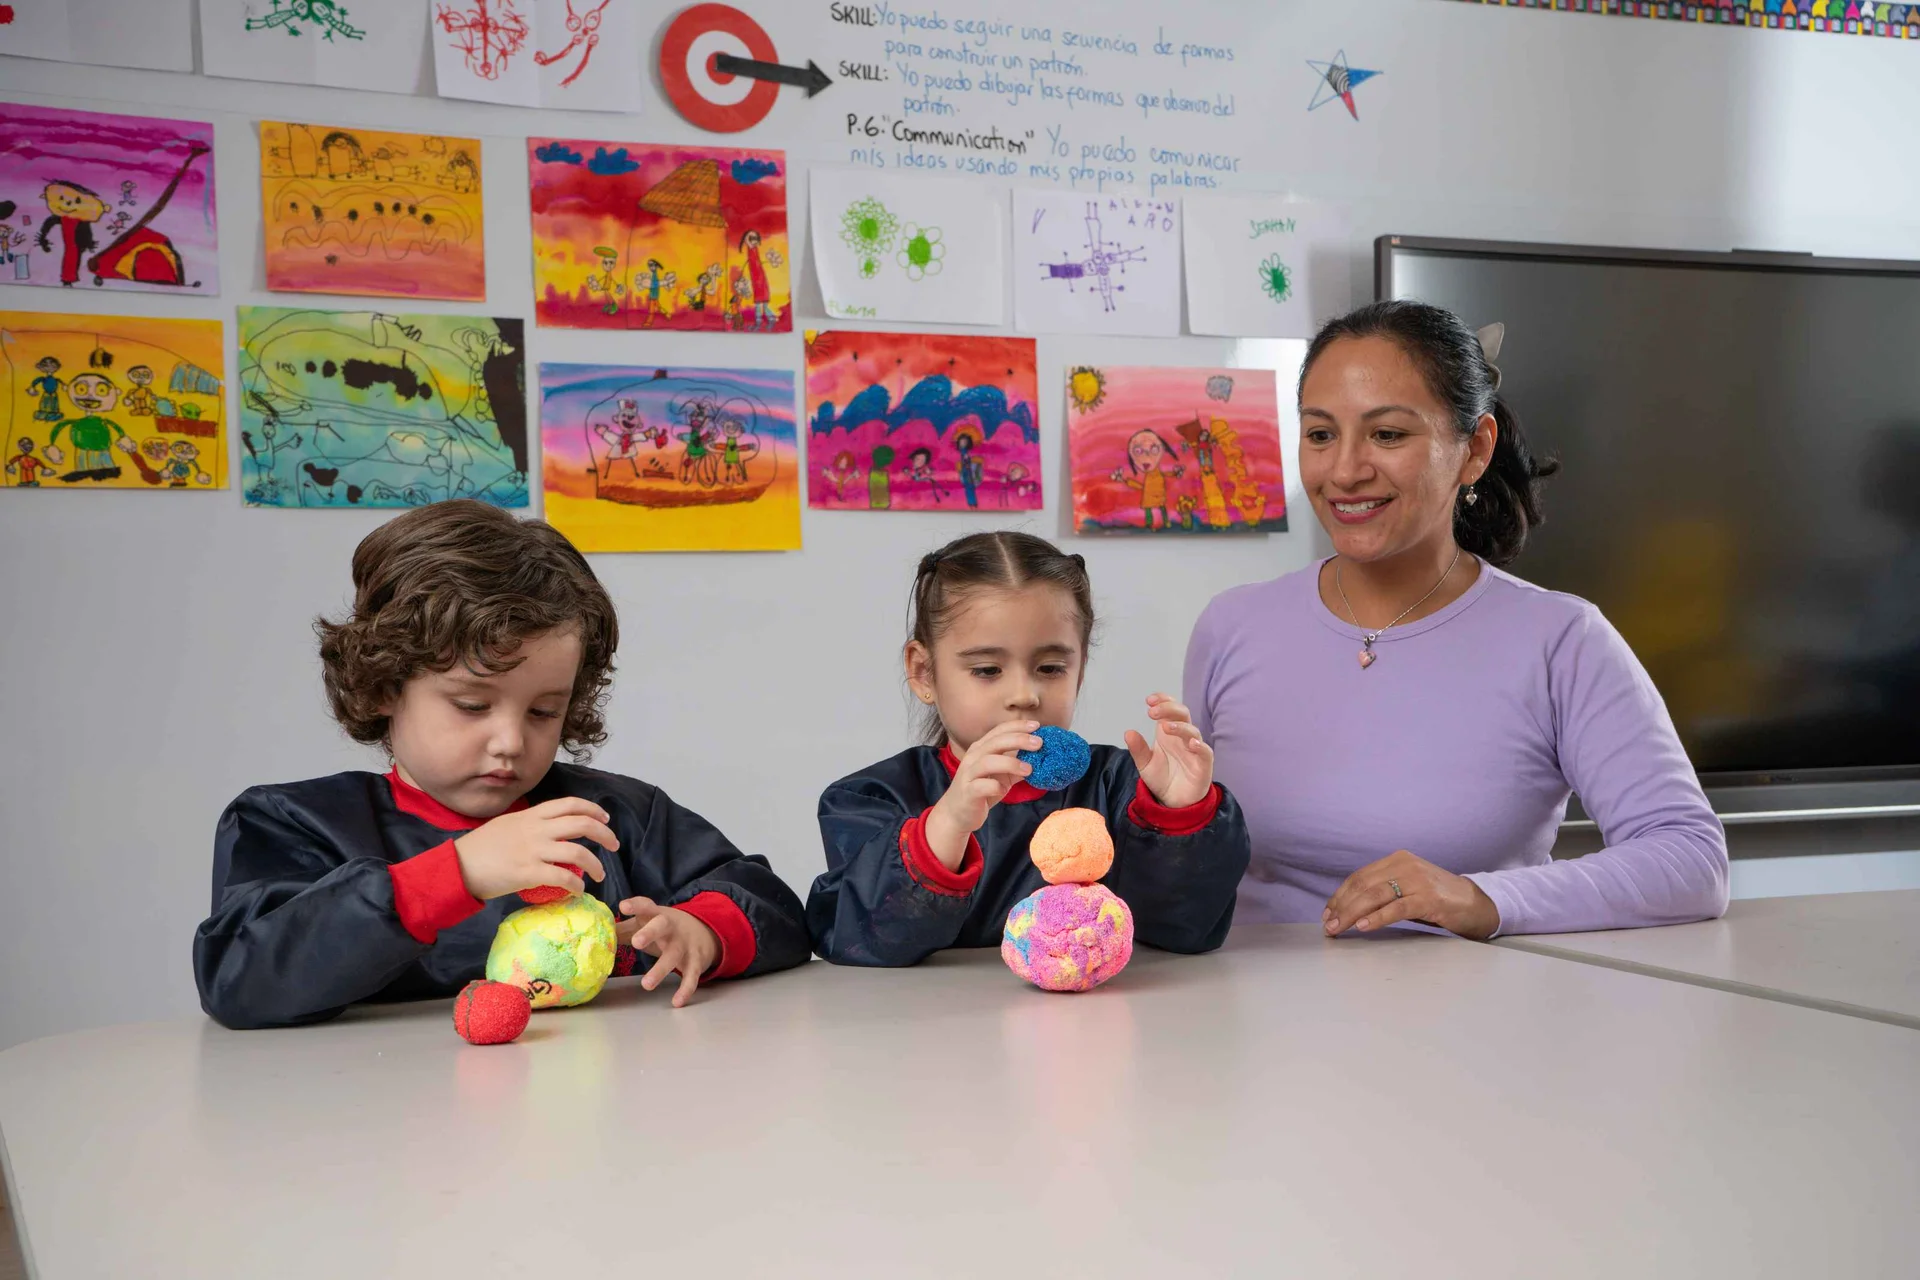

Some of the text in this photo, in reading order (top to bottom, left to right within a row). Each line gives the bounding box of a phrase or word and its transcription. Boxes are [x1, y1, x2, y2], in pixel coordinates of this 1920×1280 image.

[830, 1, 877, 27] SKILL:
[875, 1, 896, 26] Yo
[899, 11, 948, 35] puedo
[953, 17, 1014, 47] seguir
[1021, 26, 1052, 44] una
[1153, 26, 1173, 55] de
[1181, 44, 1235, 67] formas
[884, 39, 923, 61] para
[928, 42, 999, 67] construir
[1002, 55, 1023, 70] un
[839, 60, 889, 82] SKILL:
[897, 61, 919, 87] Yo
[924, 70, 972, 95] puedo
[979, 71, 1034, 106] dibujar
[1040, 78, 1064, 101] las
[1066, 85, 1124, 110] formas
[1136, 92, 1160, 118] que
[1213, 93, 1235, 117] del
[851, 141, 885, 168] mis
[896, 143, 948, 169] ideas
[955, 155, 1018, 176] usando
[1030, 161, 1060, 182] mis
[1068, 165, 1134, 194] propias
[1046, 124, 1069, 158] Yo
[1081, 136, 1136, 170] puedo
[1150, 146, 1241, 173] comunicar
